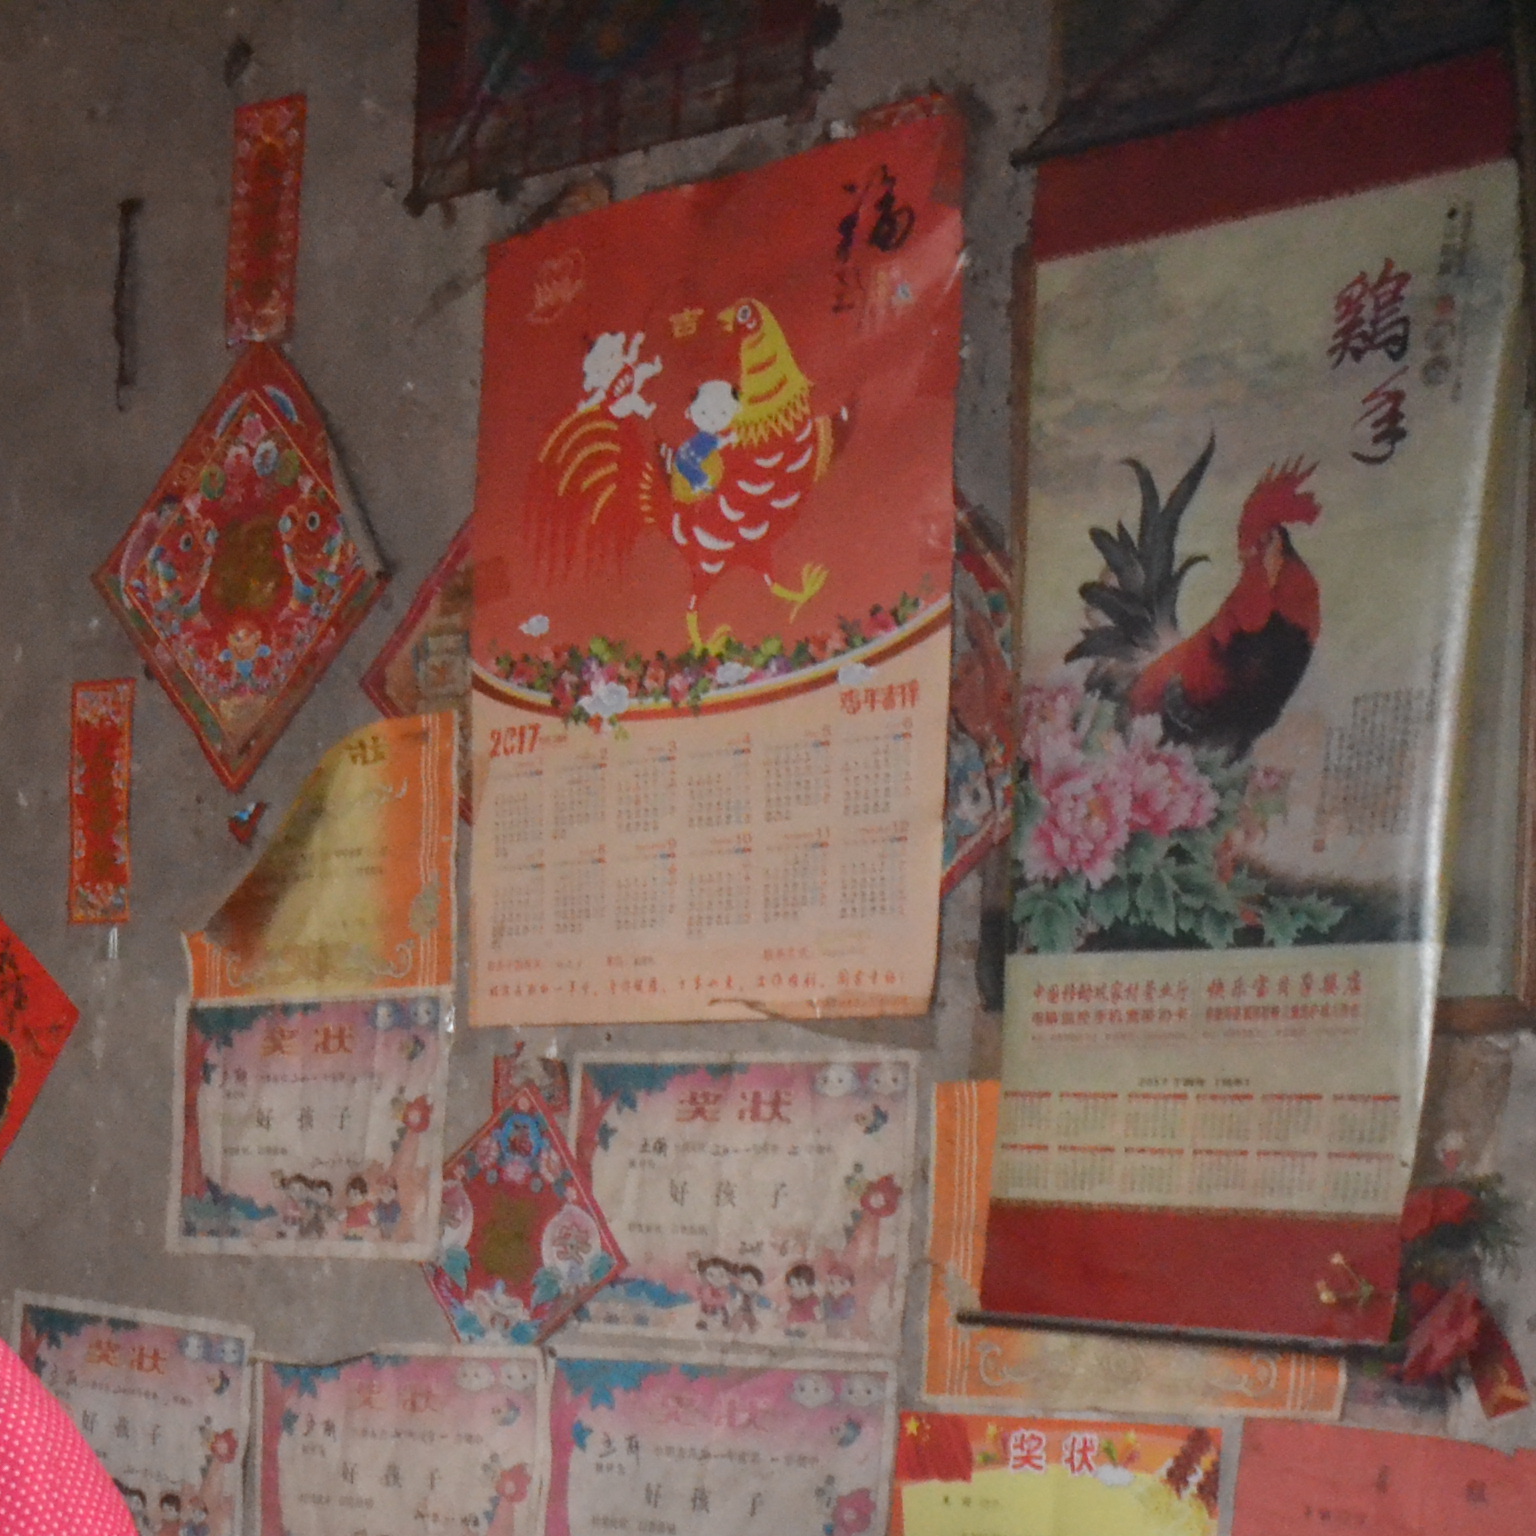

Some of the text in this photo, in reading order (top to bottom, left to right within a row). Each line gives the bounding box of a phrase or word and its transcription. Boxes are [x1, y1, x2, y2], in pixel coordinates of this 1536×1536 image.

[668, 308, 705, 339] 吉
[488, 722, 541, 758] 2017
[259, 1023, 356, 1057] 奖状
[676, 1090, 793, 1124] 奖状
[1009, 1428, 1100, 1477] 奖状
